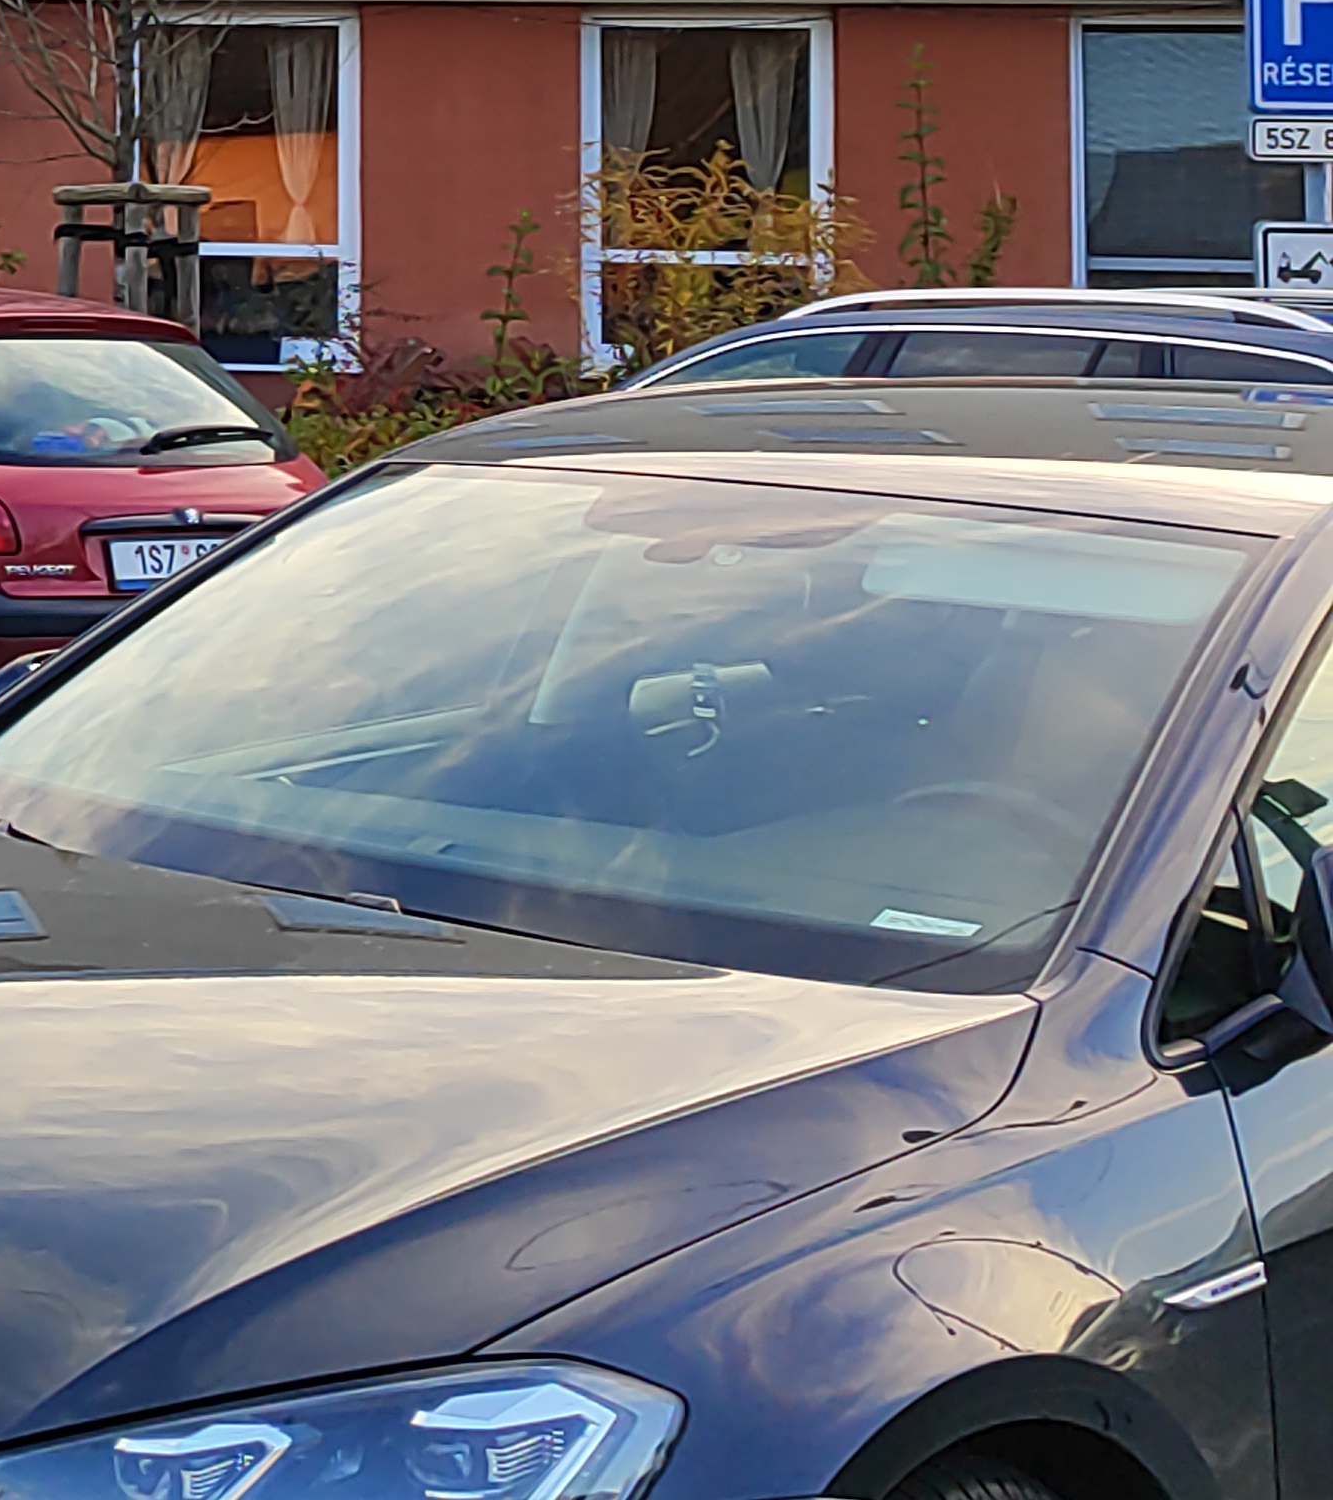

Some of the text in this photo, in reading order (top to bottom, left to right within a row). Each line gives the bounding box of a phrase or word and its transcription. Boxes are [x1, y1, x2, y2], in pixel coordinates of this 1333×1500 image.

[1263, 55, 1333, 86] RÉSE
[1266, 128, 1311, 150] 5SZ
[134, 544, 175, 575] 1S7
